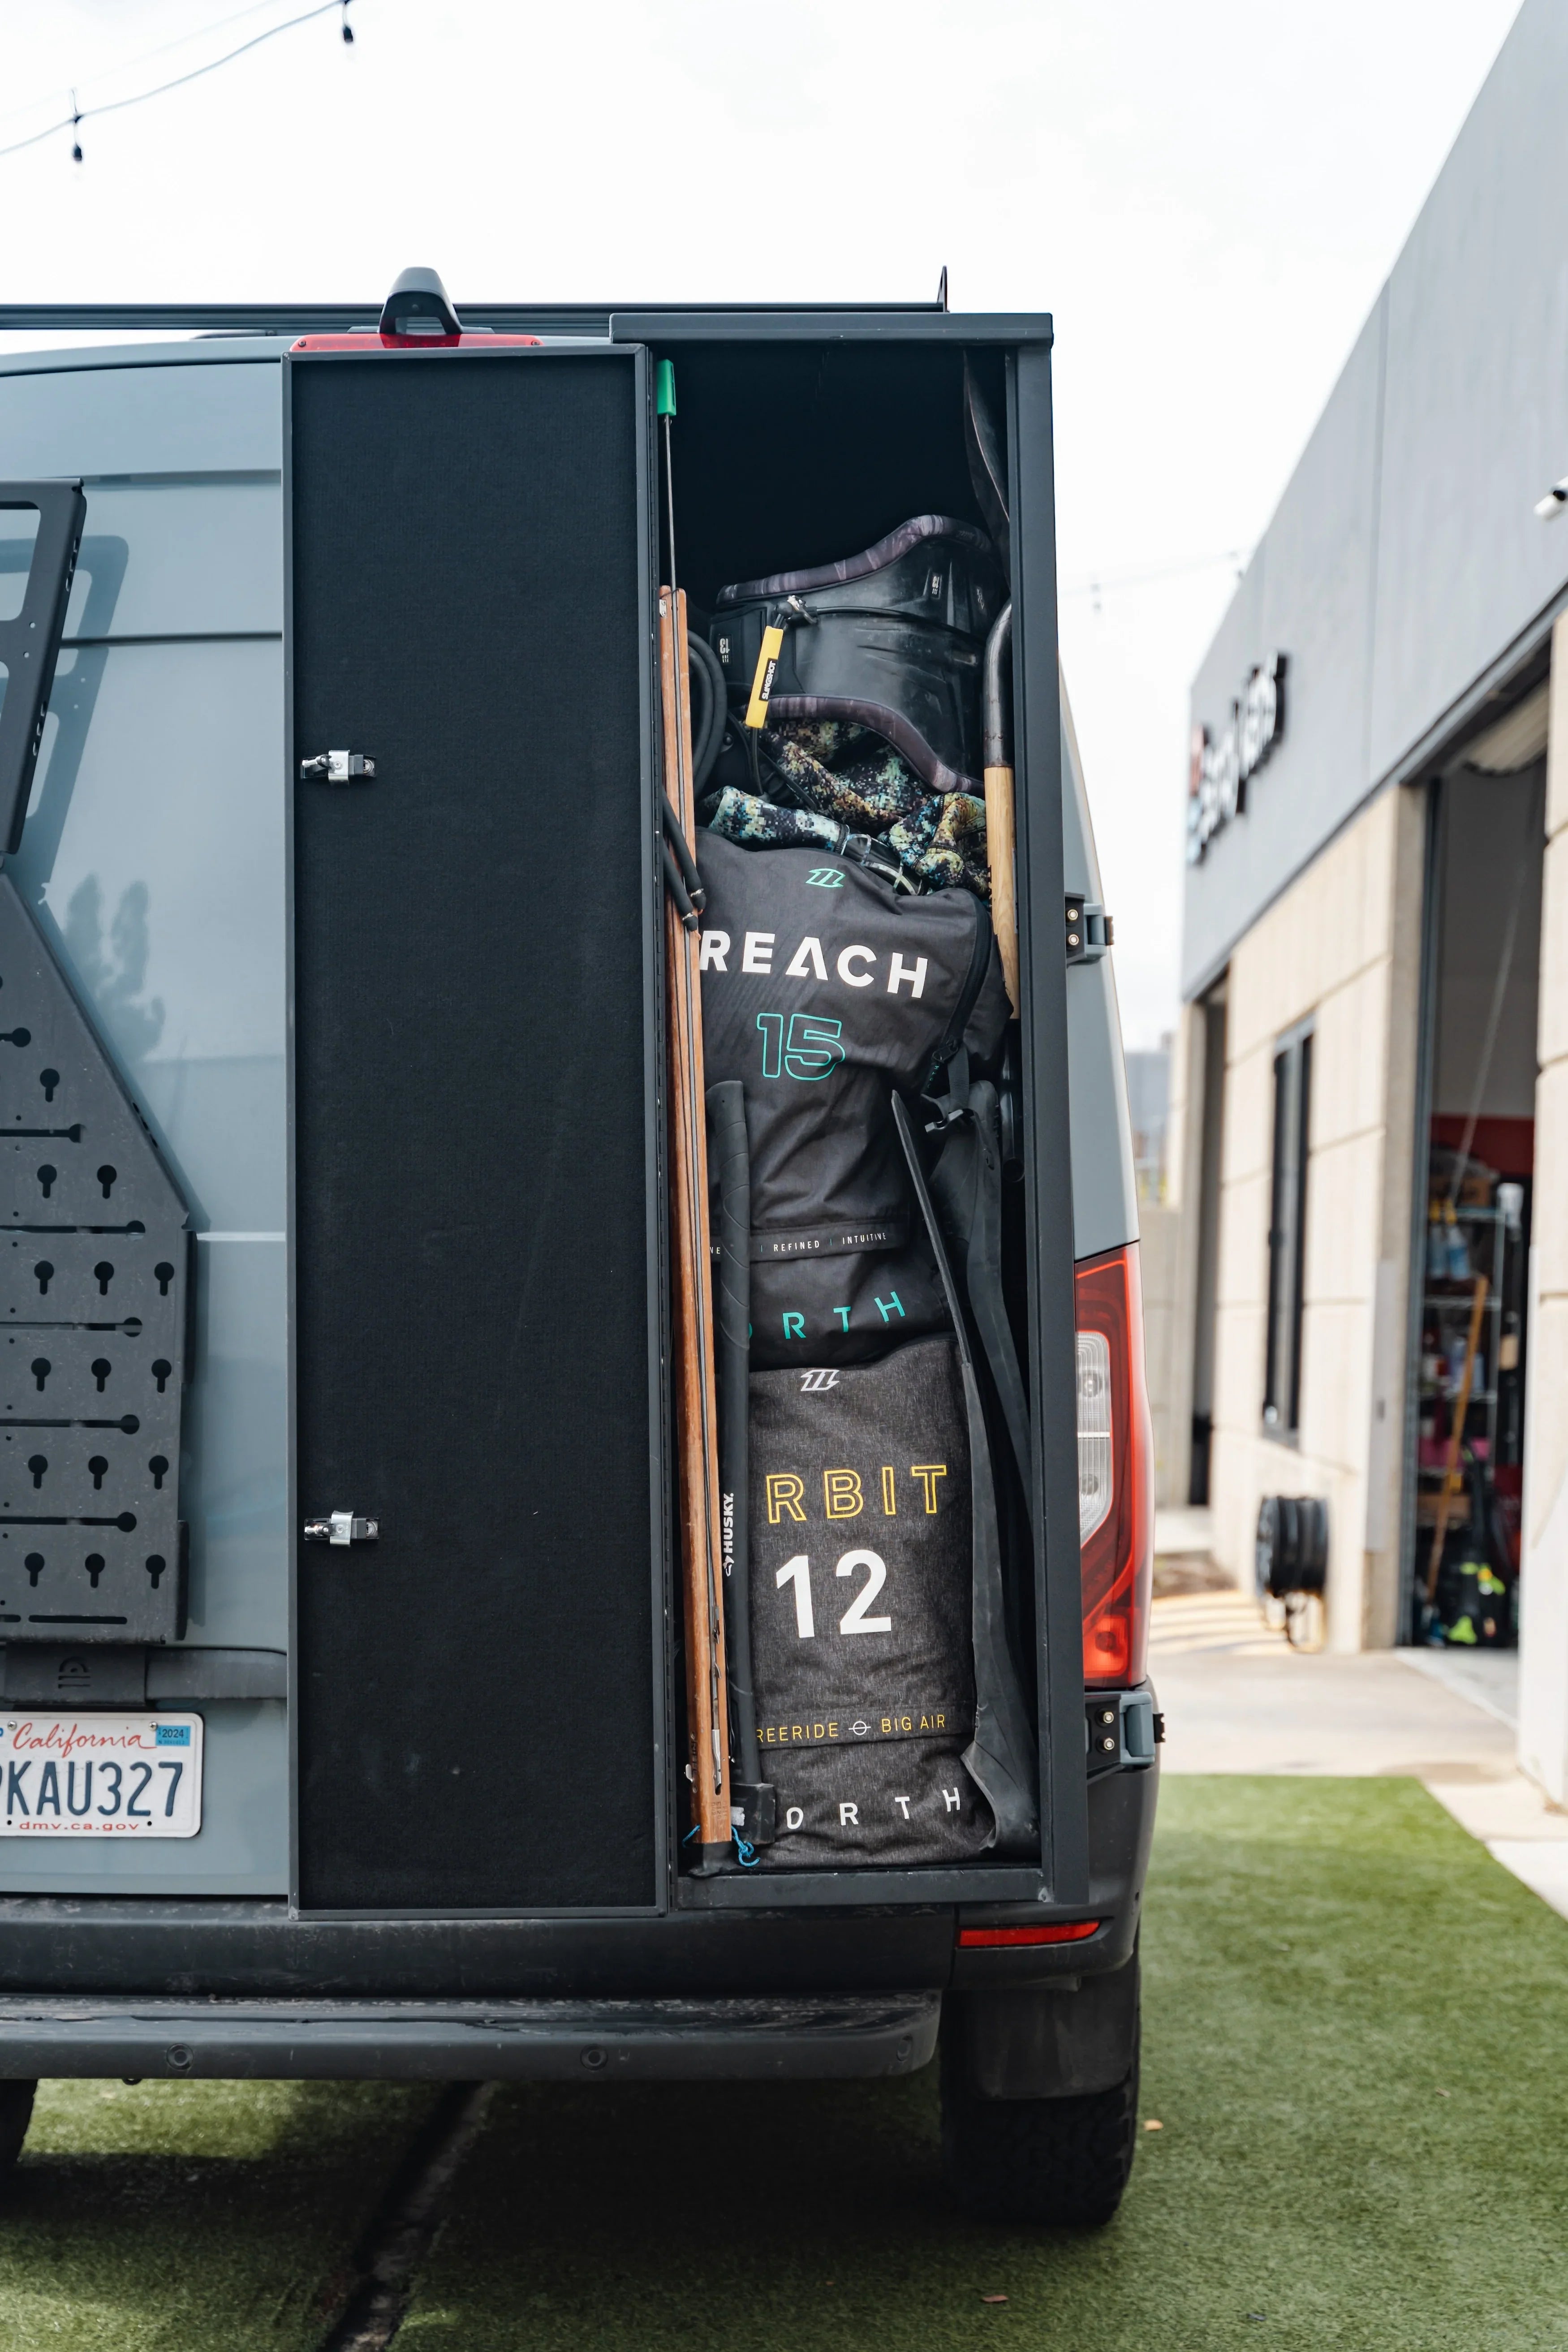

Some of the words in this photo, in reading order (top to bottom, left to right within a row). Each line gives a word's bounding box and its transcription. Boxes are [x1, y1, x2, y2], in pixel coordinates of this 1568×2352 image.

[762, 660, 776, 700] SLINGSHOT
[699, 930, 928, 999] REACH
[756, 1012, 846, 1081] 15
[774, 1240, 819, 1252] REFINED
[842, 1232, 886, 1245] INTUITIVE
[749, 1291, 905, 1340] RTH
[776, 1549, 892, 1638] 12
[13, 1723, 157, 1758] California
[162, 1728, 184, 1738] 2024
[882, 1716, 912, 1733] BIG
[920, 1714, 945, 1730] AIR
[0, 1761, 183, 1817] KAU327
[786, 1787, 961, 1829] ORTH
[19, 1822, 139, 1831] dmv.ca.gov
